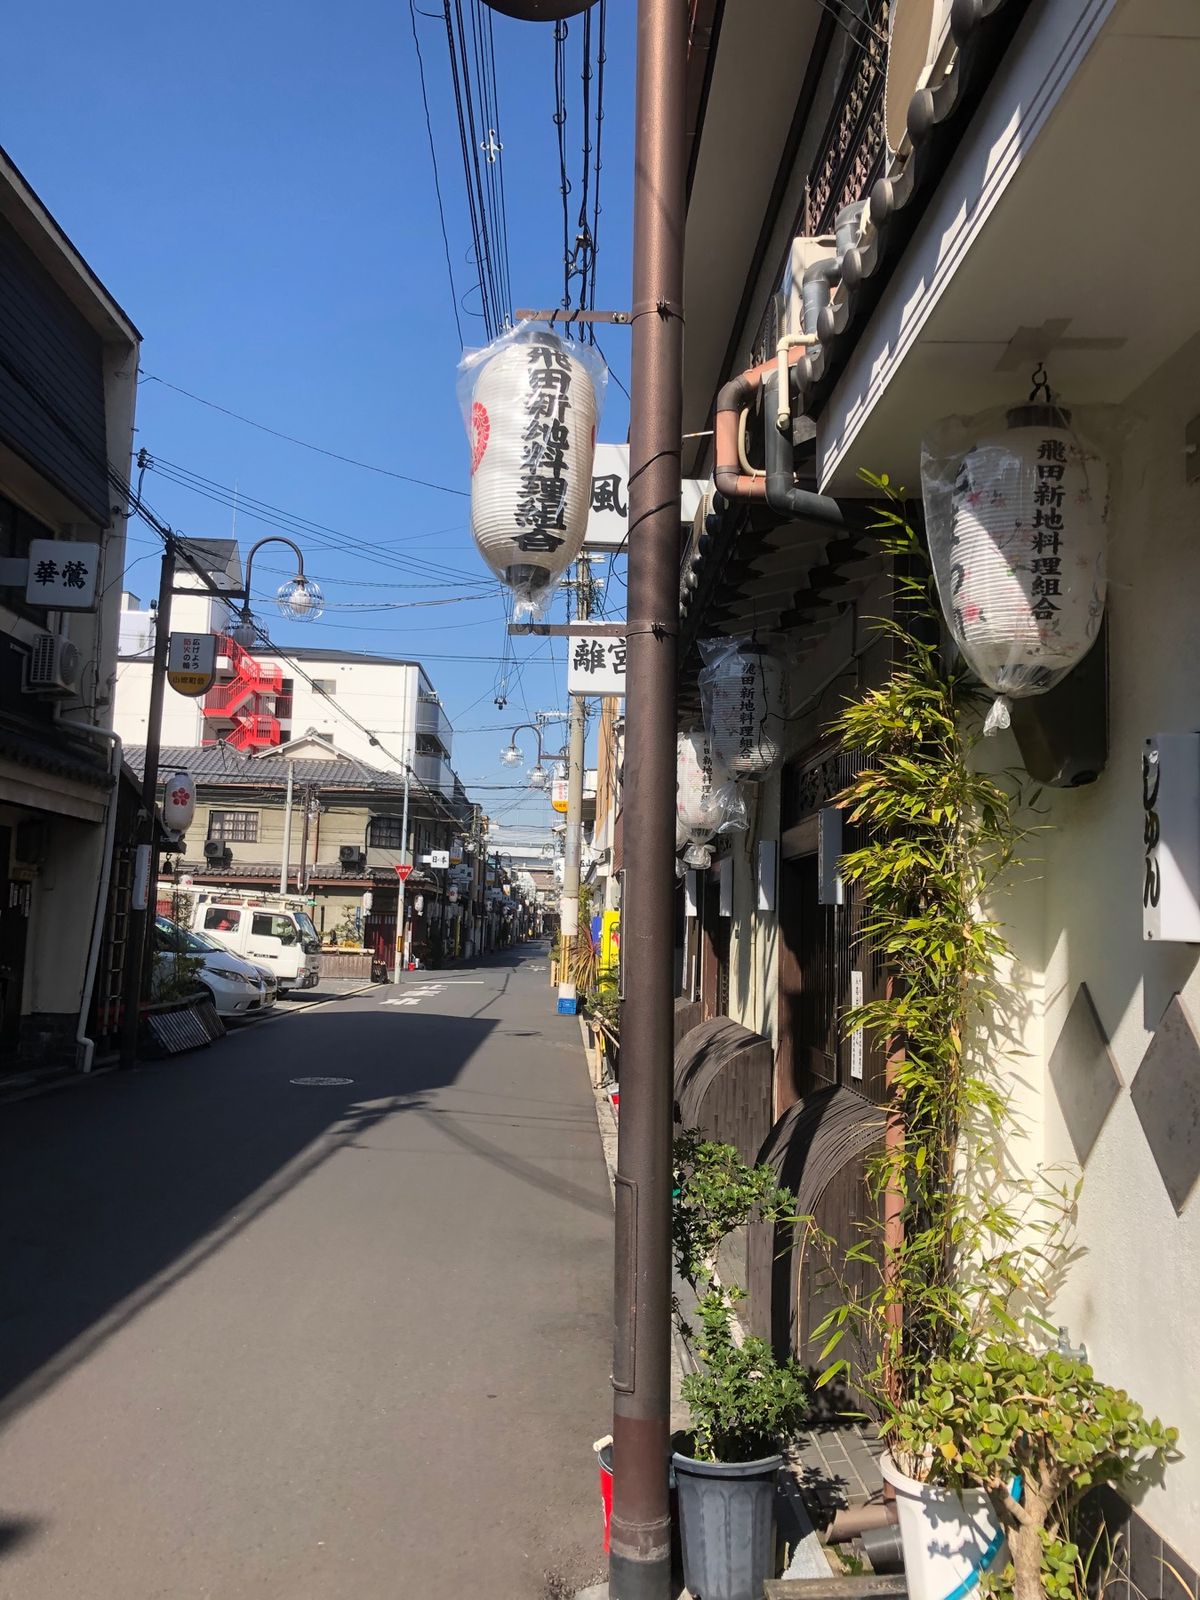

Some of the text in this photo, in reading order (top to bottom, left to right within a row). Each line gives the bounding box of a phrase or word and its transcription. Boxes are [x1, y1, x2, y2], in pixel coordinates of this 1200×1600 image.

[510, 345, 572, 553] 飛田新地料理組合
[589, 474, 628, 518] 風
[1031, 439, 1068, 621] 飛田新地料理組合
[191, 639, 201, 670] 広げよう
[738, 662, 757, 760] 飛田新地料理組合
